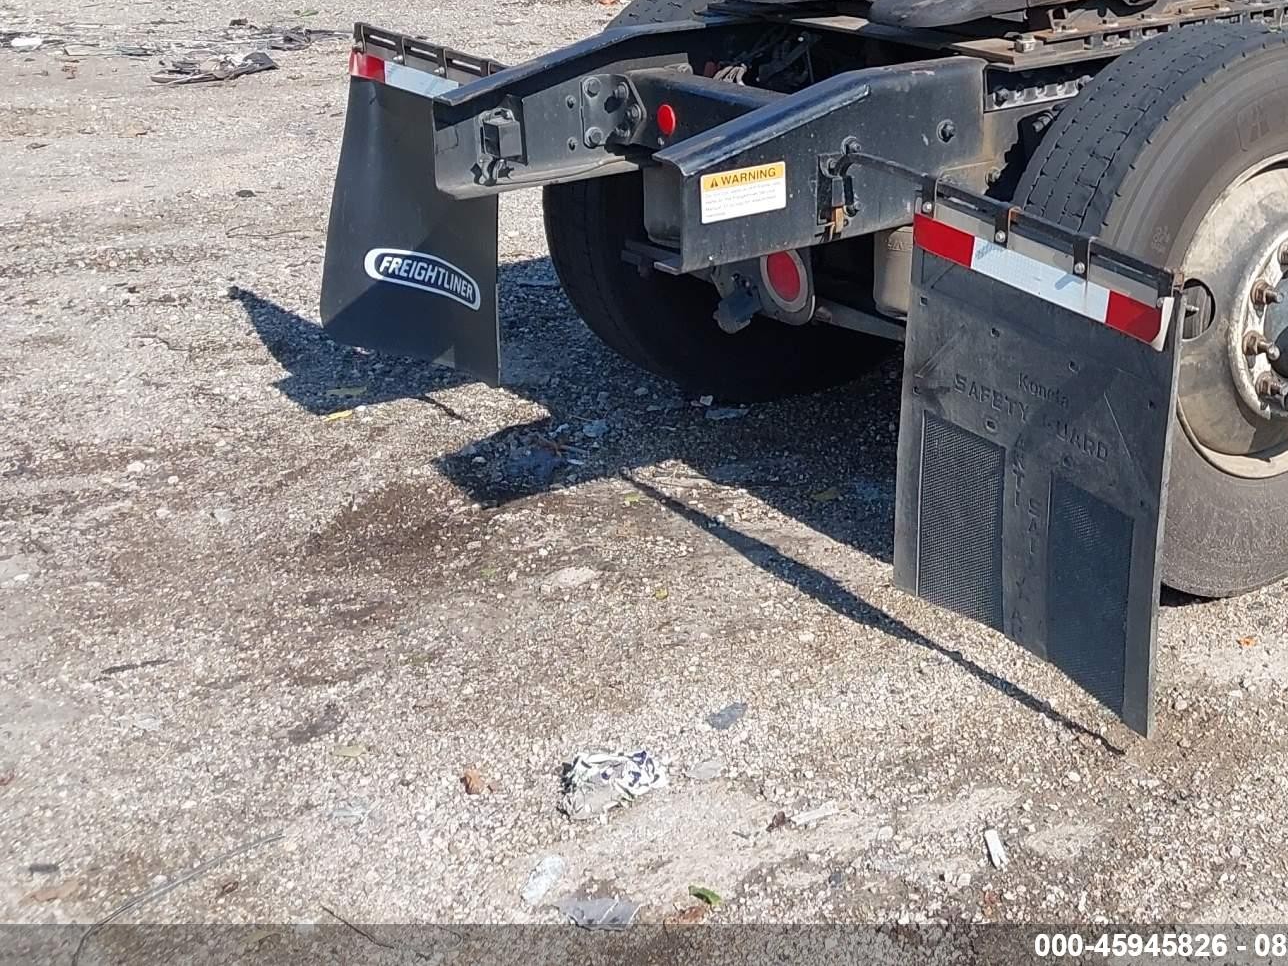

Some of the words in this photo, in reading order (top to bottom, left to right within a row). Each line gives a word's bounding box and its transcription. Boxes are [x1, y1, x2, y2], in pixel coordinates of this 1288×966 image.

[721, 167, 776, 186] WARNING
[380, 256, 474, 301] FREIGHTLINER
[953, 373, 1029, 424] SAFETY
